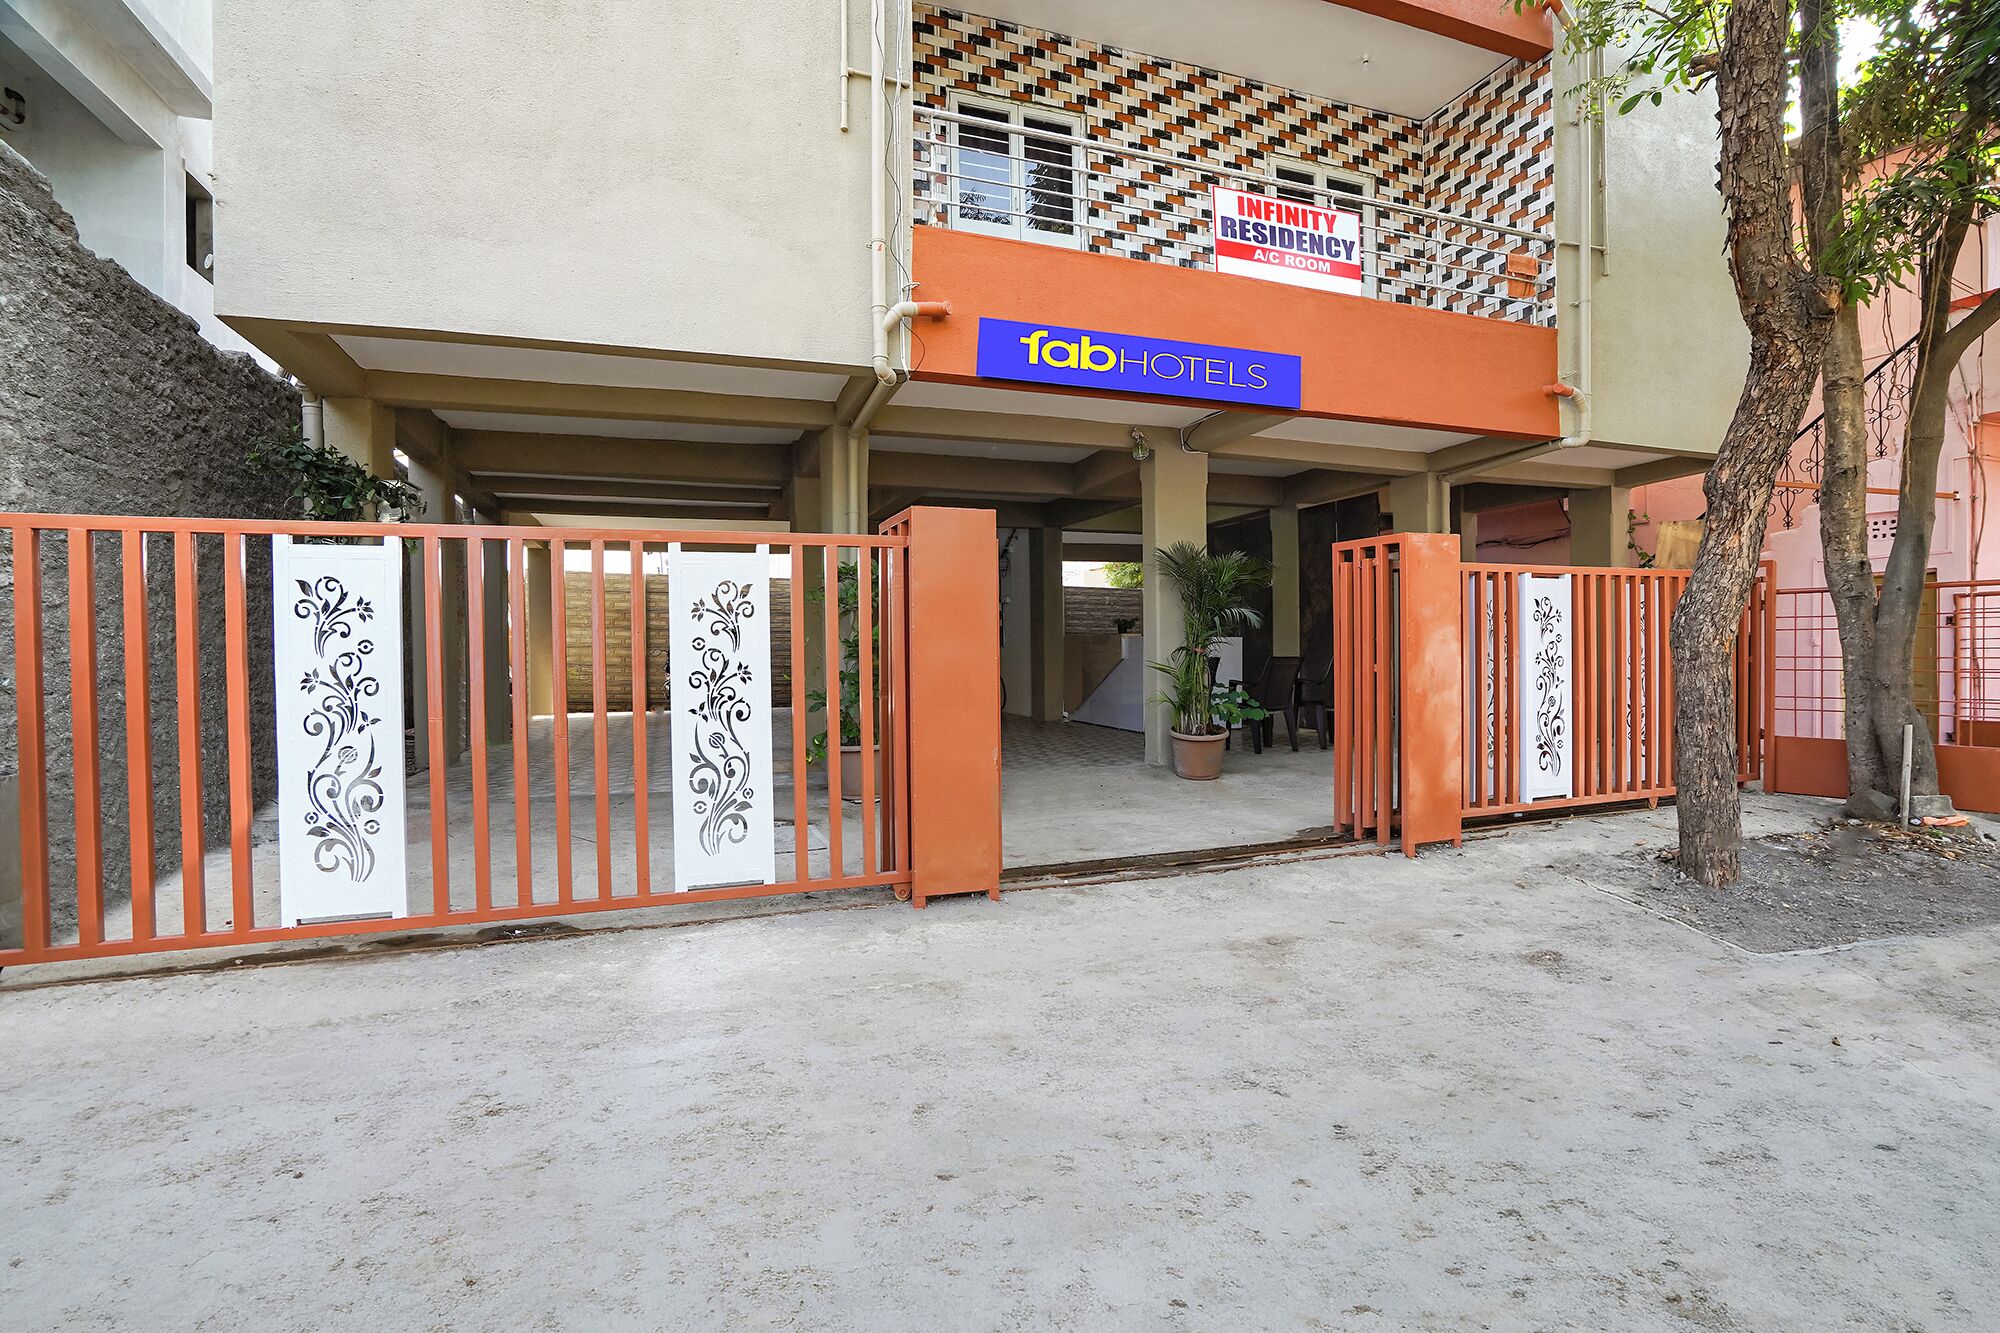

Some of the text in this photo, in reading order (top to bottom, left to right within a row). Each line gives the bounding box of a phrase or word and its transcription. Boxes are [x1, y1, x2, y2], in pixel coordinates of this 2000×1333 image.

[1236, 195, 1338, 234] INFINITY
[1220, 216, 1356, 261] RESIDENCY
[1253, 248, 1331, 273] A/C ROOM
[1020, 330, 1268, 390] fabHOTELS
